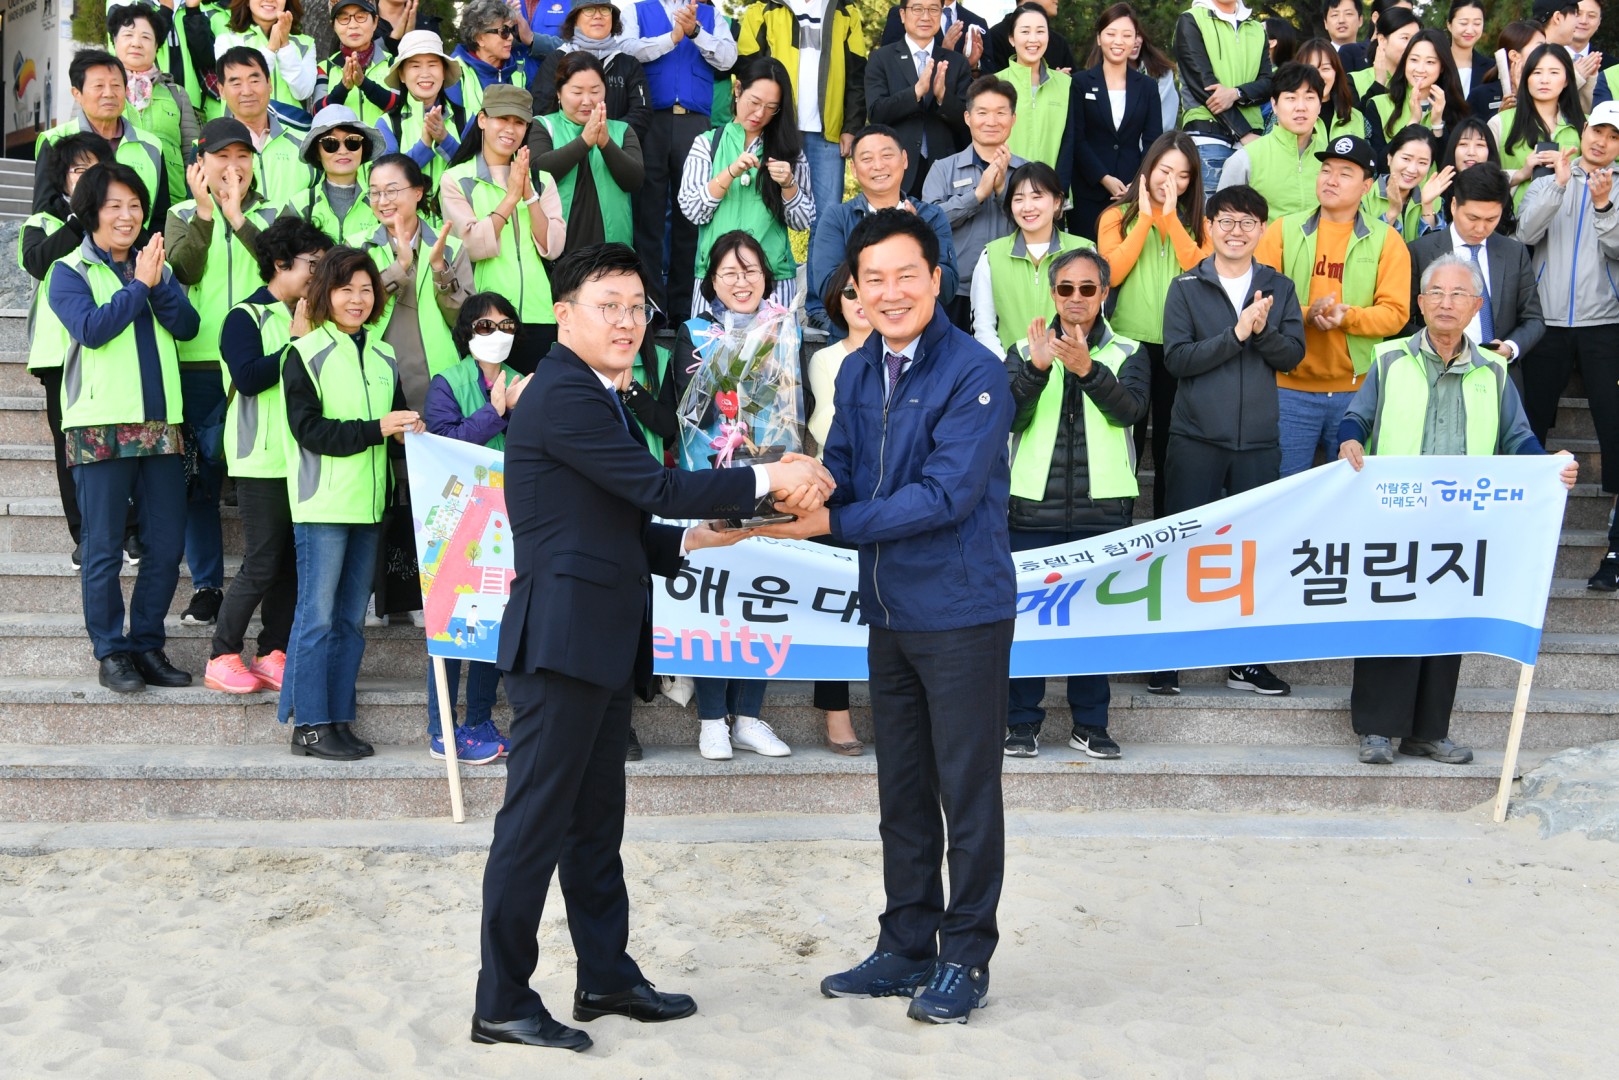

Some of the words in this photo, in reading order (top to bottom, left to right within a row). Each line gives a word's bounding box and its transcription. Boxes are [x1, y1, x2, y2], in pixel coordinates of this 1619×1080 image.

[1376, 482, 1423, 494] 사람중심
[1431, 477, 1524, 511] 해운대
[1381, 495, 1428, 508] 미래도시
[1101, 519, 1203, 557] 함께하는
[1289, 538, 1488, 606] 챌린지
